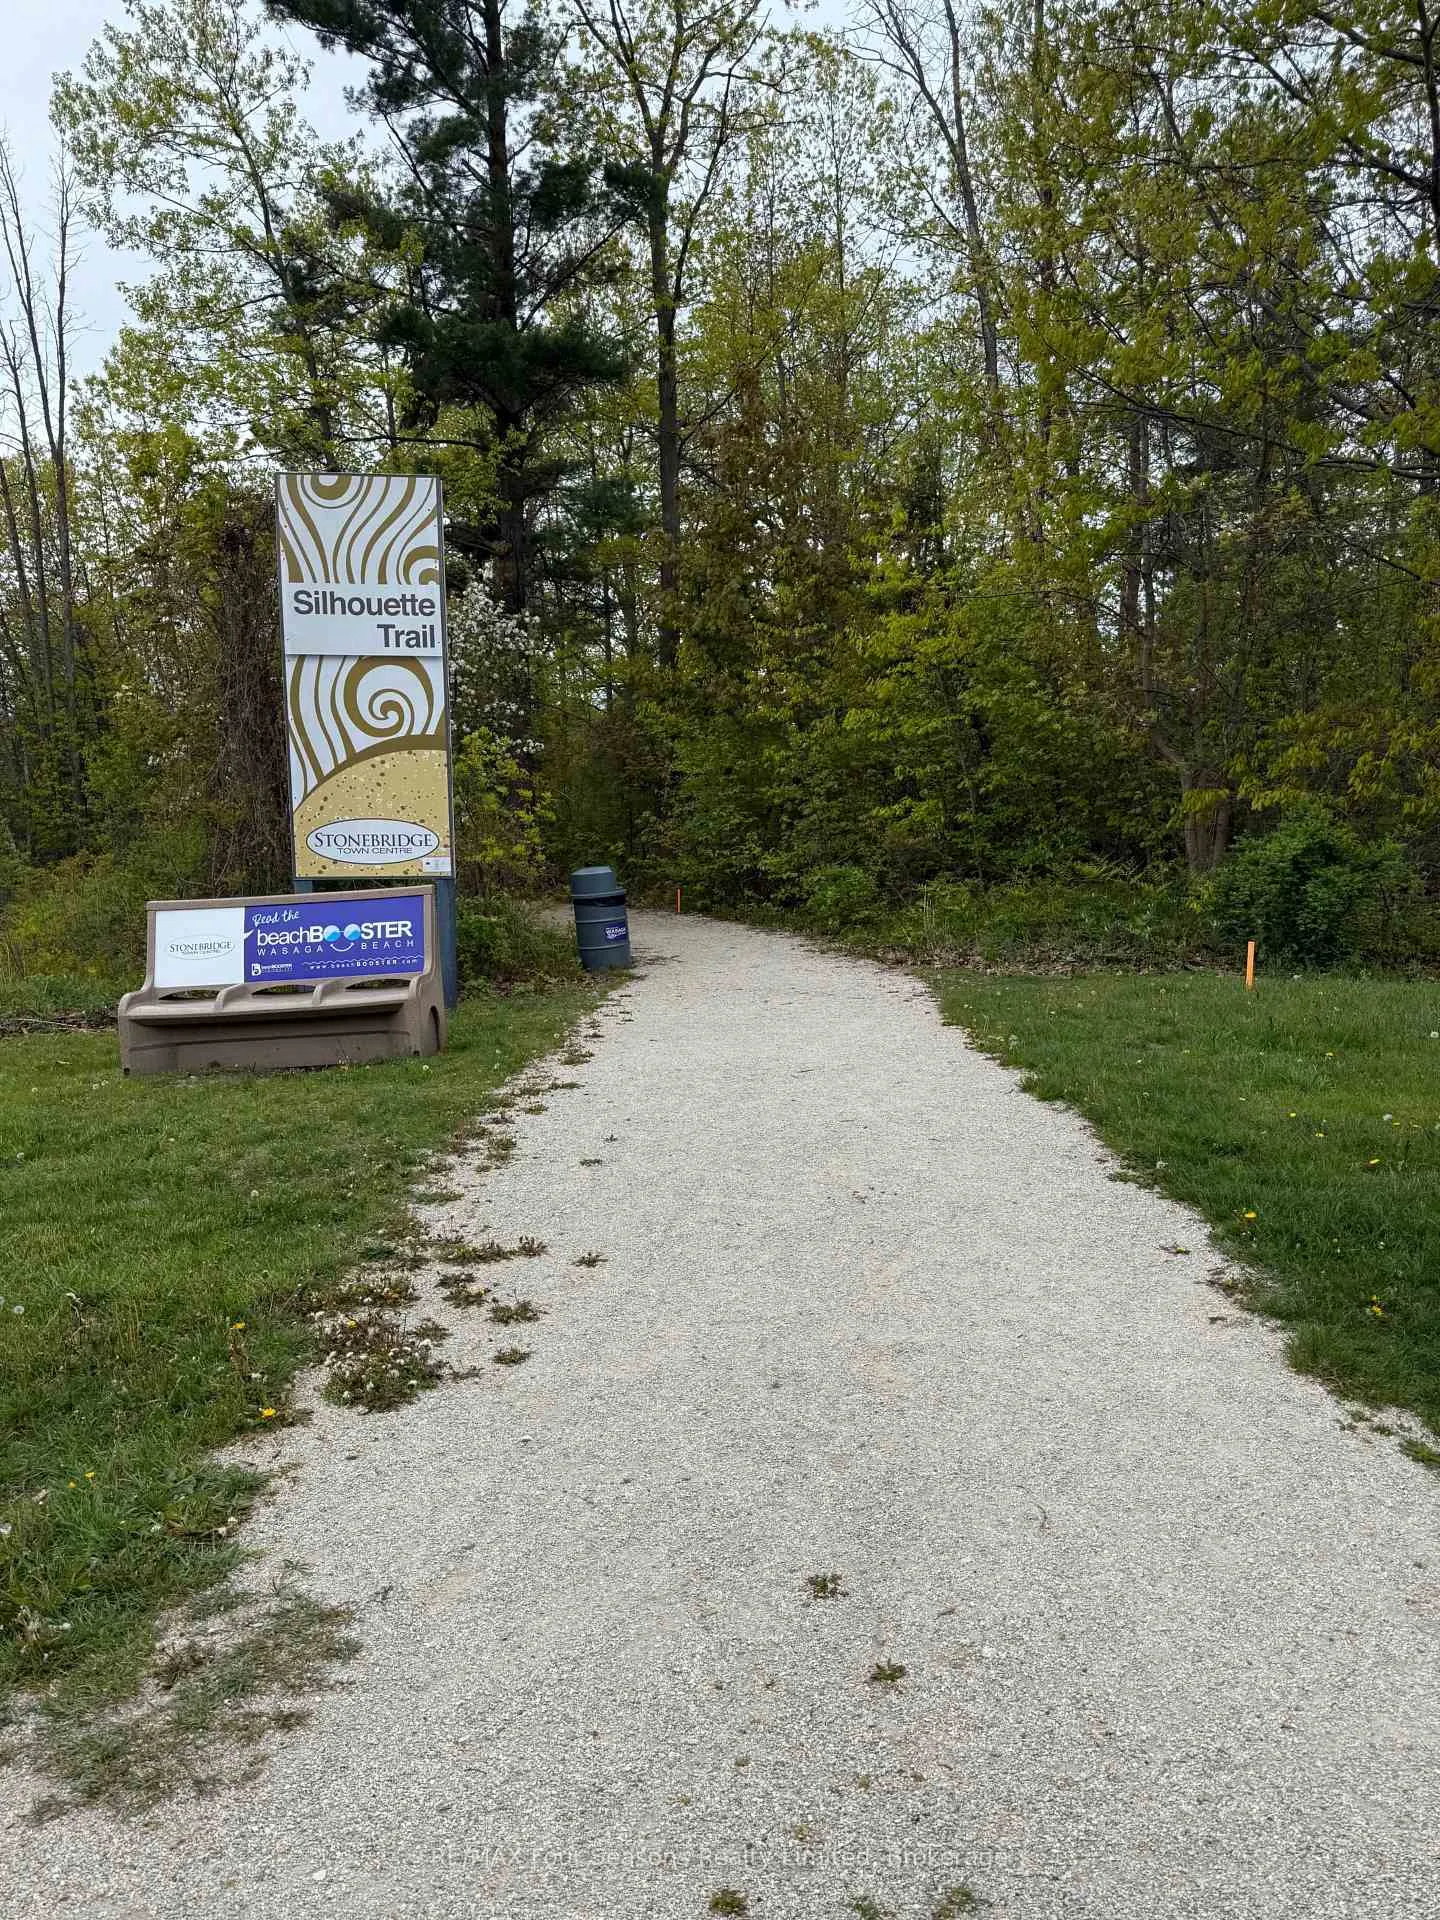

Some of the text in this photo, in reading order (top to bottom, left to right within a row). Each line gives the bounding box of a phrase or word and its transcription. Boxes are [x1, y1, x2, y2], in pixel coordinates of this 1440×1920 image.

[293, 589, 435, 616] Silhouette
[376, 624, 435, 648] Trail
[314, 832, 433, 847] STONEBRIDGE
[252, 910, 301, 927] Read the
[257, 939, 414, 956] WASAGA BEACH
